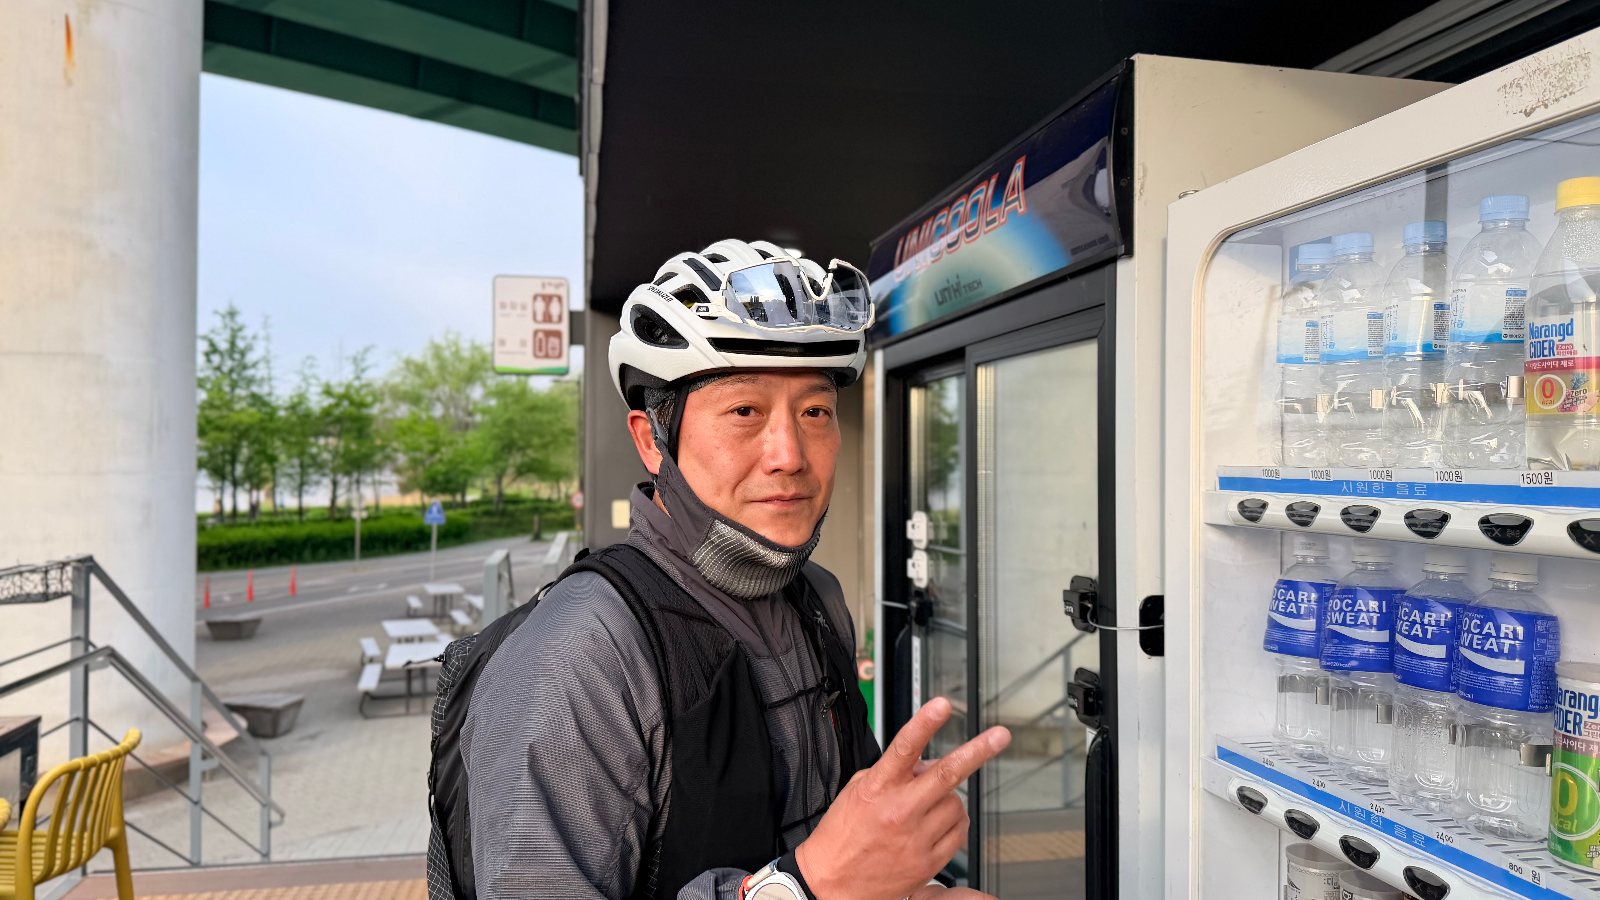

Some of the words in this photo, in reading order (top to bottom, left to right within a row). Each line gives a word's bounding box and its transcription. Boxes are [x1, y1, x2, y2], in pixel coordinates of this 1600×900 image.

[1528, 318, 1574, 342] Narangd
[1262, 468, 1281, 479] 1000원
[1311, 469, 1331, 480] 1000원
[1369, 469, 1393, 481] 1000원
[1435, 471, 1463, 483] 1000원
[1520, 471, 1554, 485] 1500원
[1341, 481, 1385, 494] 시원한
[1396, 483, 1428, 496] 음료
[1328, 599, 1387, 613] POCARI
[1326, 611, 1380, 626] SWEAT
[1508, 862, 1523, 875] 800
[1531, 869, 1541, 885] 원
